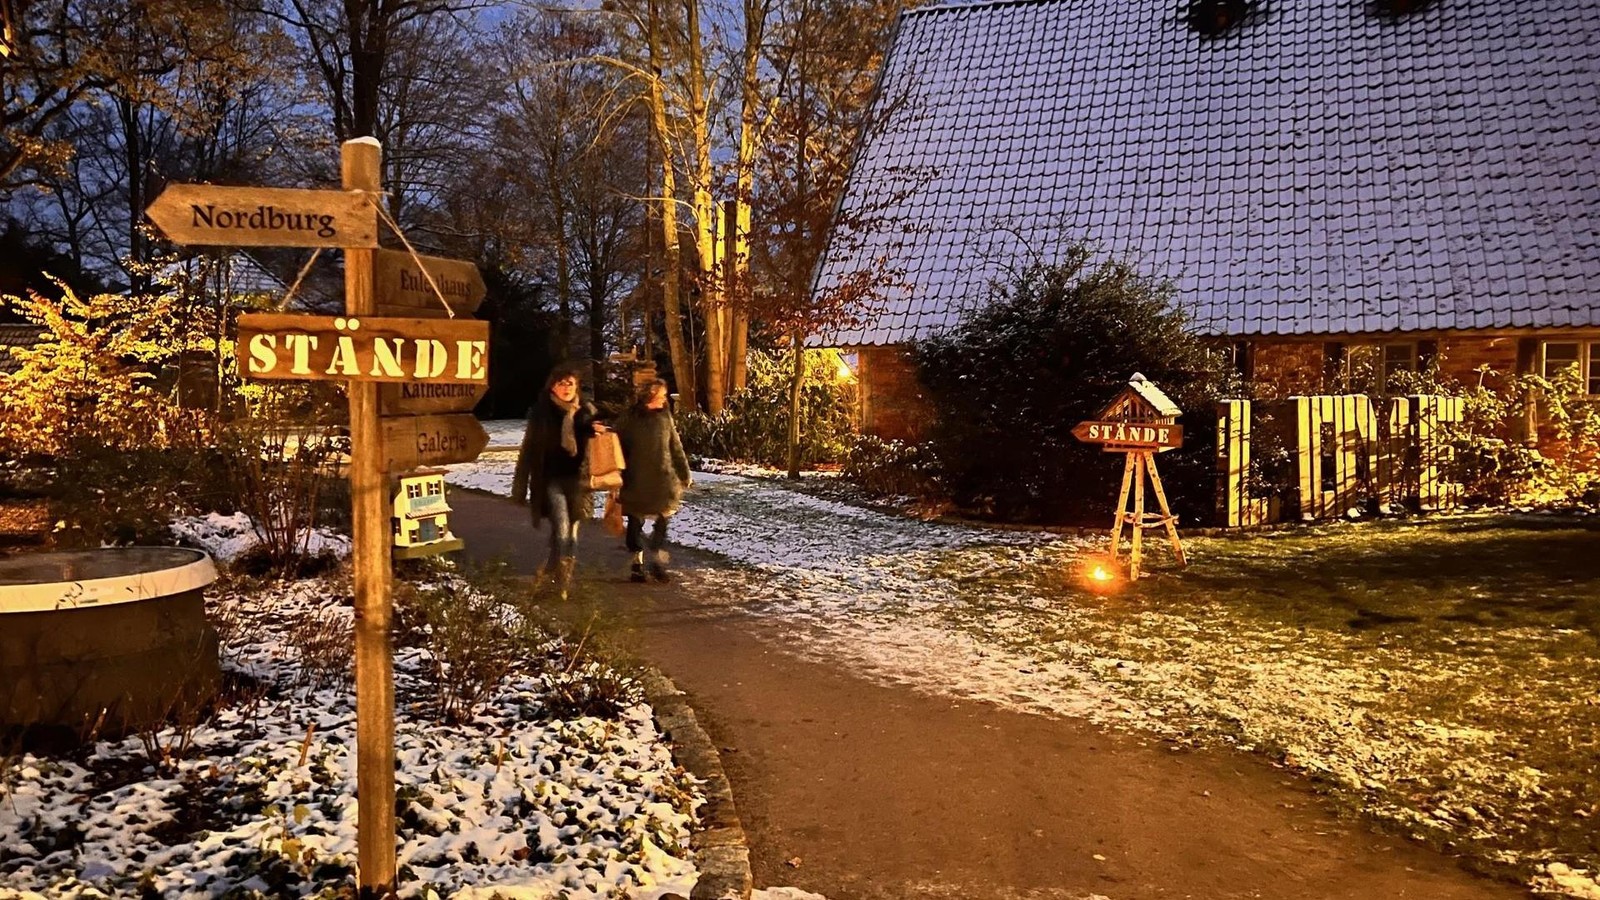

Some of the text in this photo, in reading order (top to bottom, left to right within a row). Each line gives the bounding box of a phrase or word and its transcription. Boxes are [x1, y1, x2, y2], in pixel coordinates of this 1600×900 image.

[190, 204, 337, 238] Nordburg
[248, 318, 487, 379] STÄNDE
[416, 431, 467, 453] Galerie
[1088, 422, 1170, 444] STÄNDE
